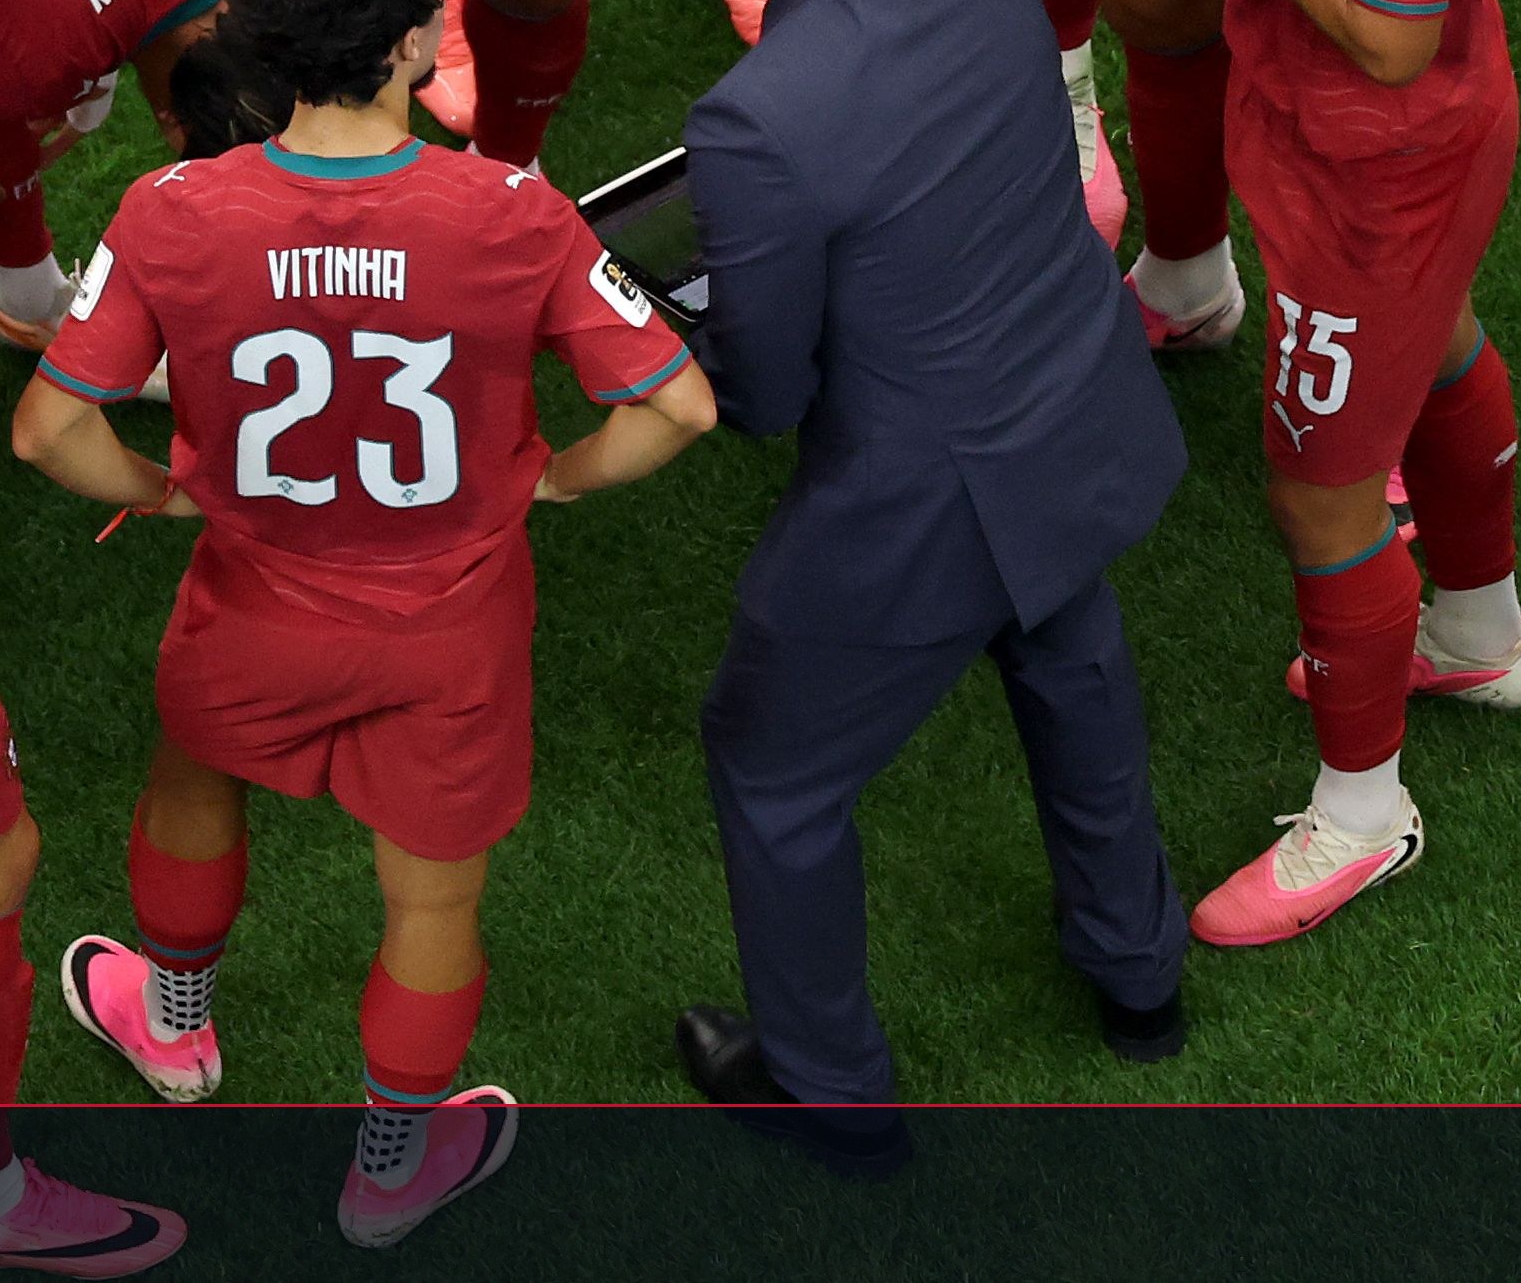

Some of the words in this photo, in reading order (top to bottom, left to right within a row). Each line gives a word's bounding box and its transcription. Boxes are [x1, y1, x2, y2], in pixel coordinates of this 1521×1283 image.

[266, 245, 407, 302] VITINHA
[1274, 291, 1358, 416] 15
[230, 326, 460, 510] 23
